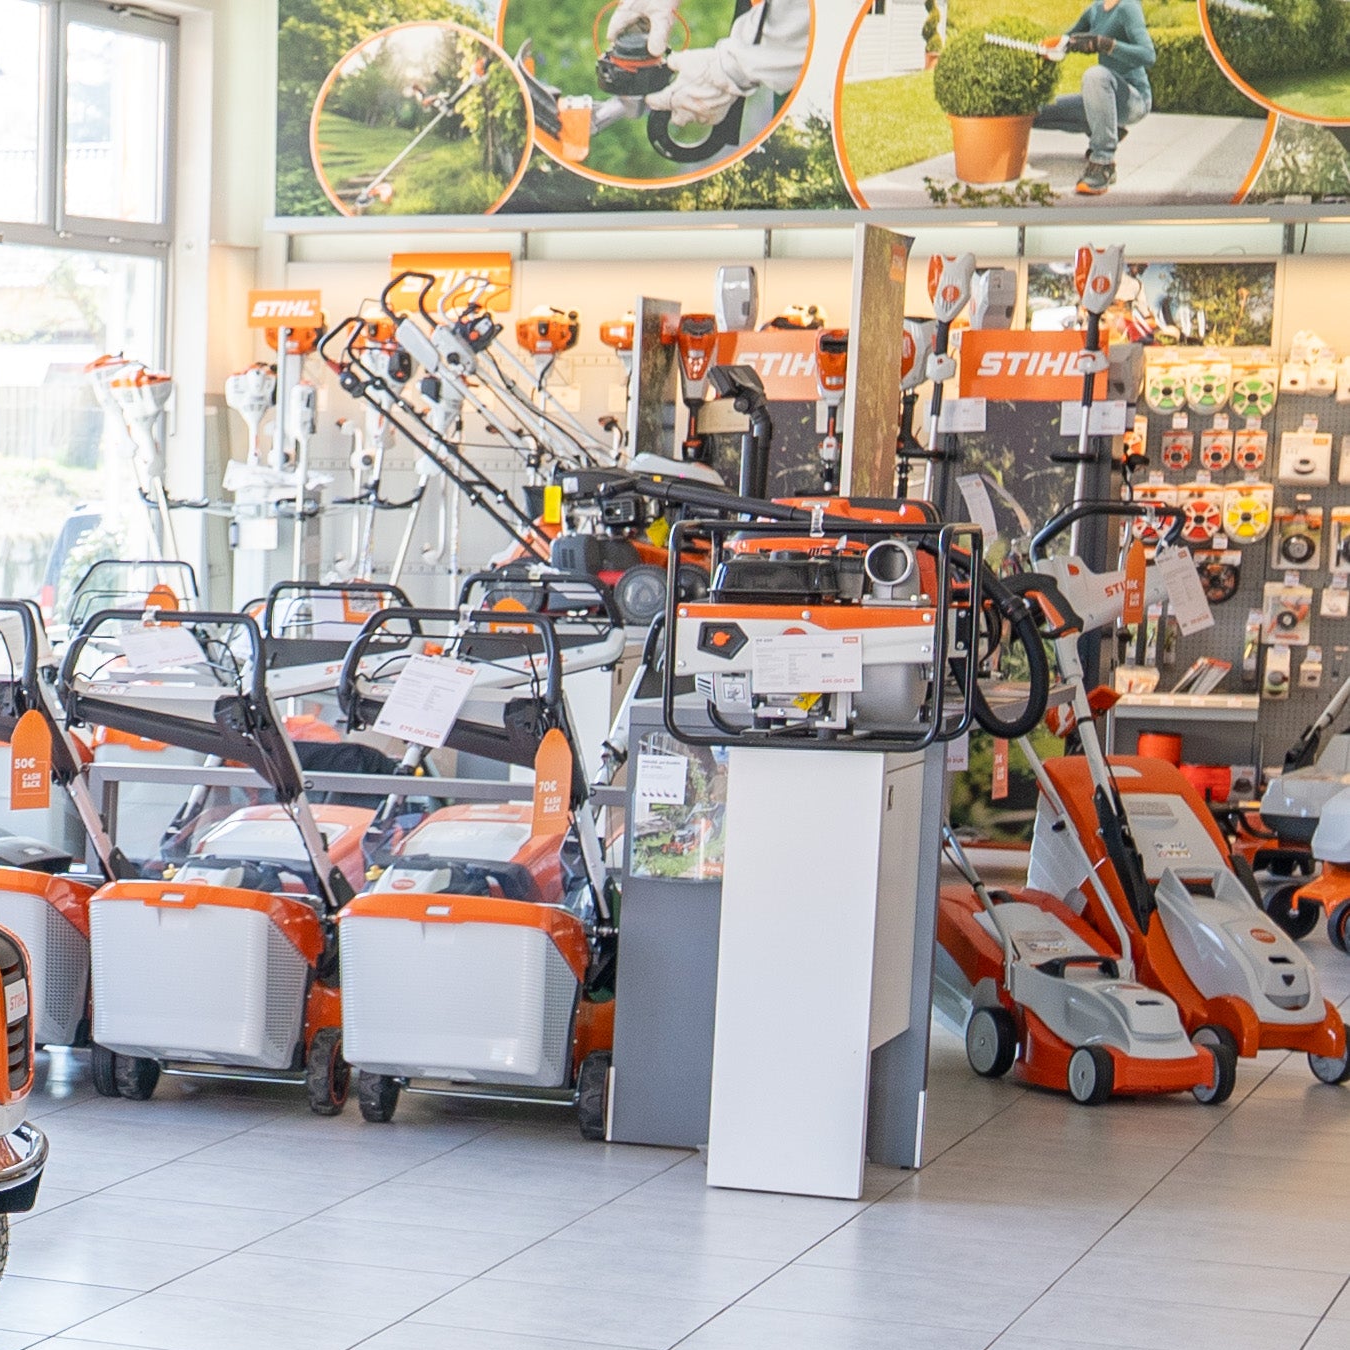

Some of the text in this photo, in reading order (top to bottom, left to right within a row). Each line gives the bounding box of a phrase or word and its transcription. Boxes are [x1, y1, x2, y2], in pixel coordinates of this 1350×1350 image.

[251, 300, 315, 318] STIHL
[14, 757, 36, 769] 50€
[22, 772, 42, 782] CASH
[22, 779, 41, 789] BACK
[538, 780, 558, 793] 70€
[10, 992, 27, 1011] STIHL
